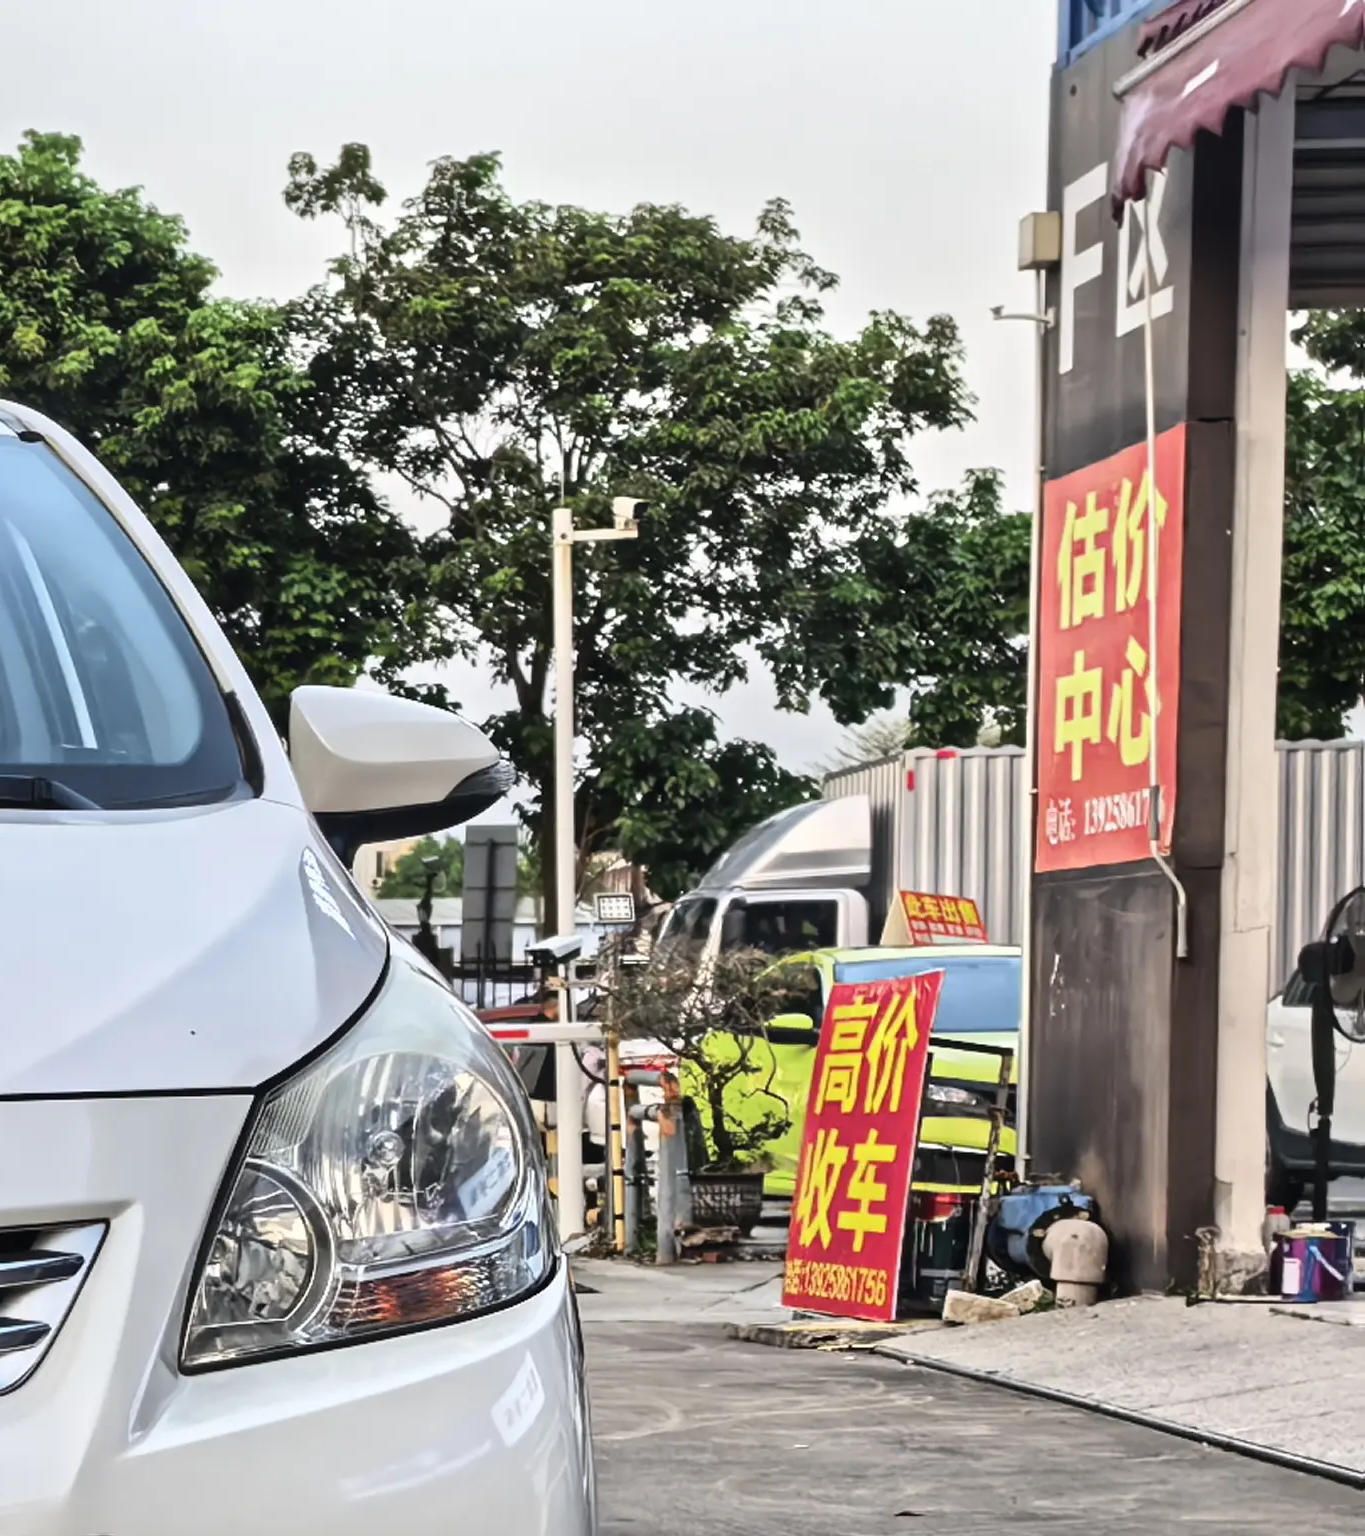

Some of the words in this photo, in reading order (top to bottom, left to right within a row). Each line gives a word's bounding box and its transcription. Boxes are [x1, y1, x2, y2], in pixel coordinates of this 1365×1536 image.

[1057, 470, 1169, 630] 估价
[1054, 635, 1162, 782] 中心
[815, 993, 919, 1115] 高价
[796, 1127, 897, 1252] 收车
